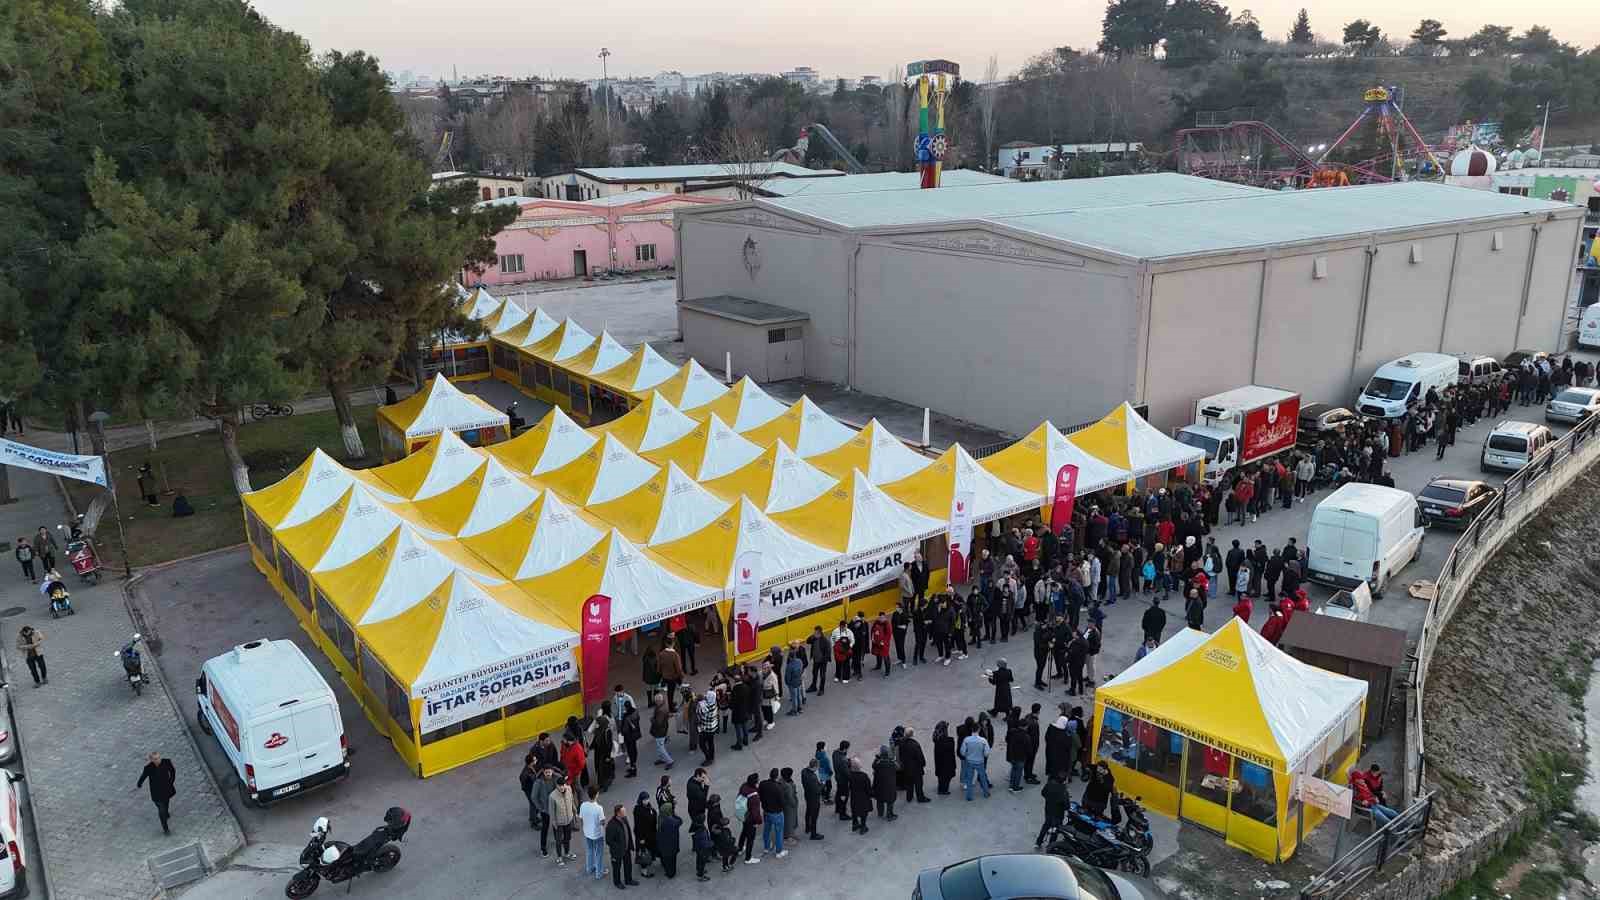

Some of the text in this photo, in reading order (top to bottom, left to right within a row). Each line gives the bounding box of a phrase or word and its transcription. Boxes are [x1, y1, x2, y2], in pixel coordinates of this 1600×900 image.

[771, 575, 832, 607] HAYIRLI
[834, 552, 903, 586] İFTARLAR
[426, 691, 476, 716] İFTAR
[480, 661, 571, 697] SOFRASI'na
